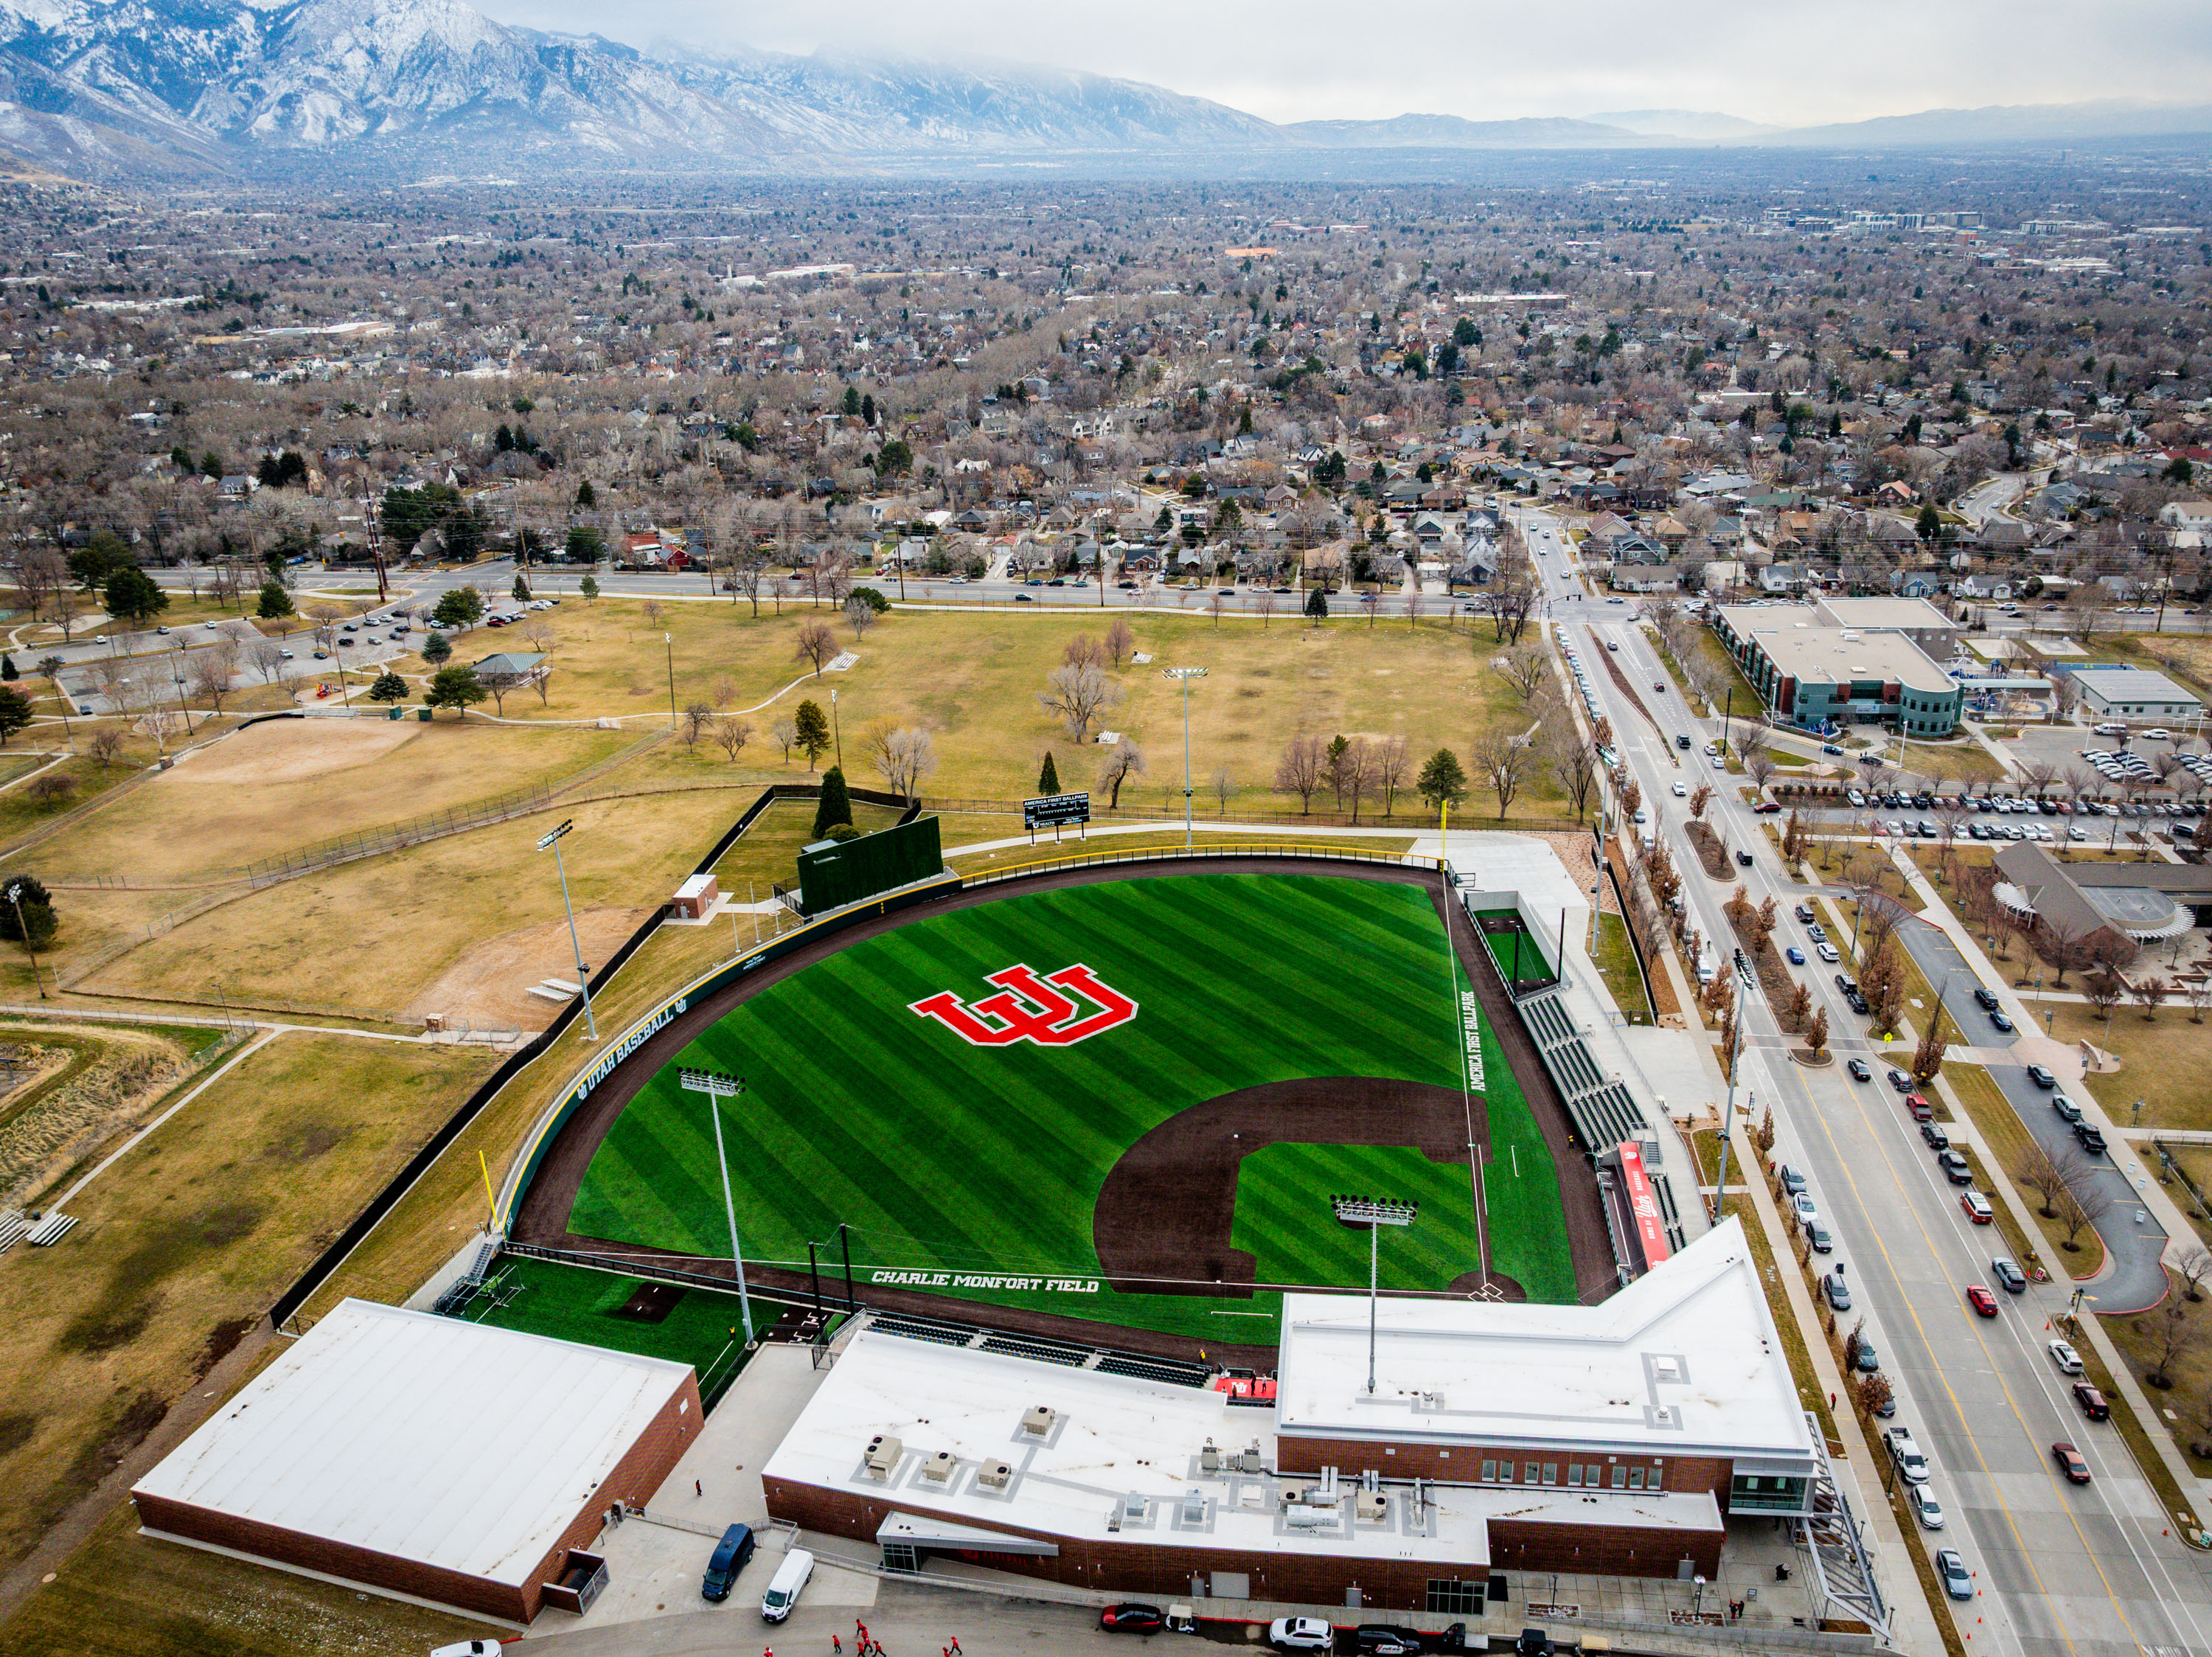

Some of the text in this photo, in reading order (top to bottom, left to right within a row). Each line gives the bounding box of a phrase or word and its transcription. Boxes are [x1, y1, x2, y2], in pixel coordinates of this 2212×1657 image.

[586, 1055, 616, 1091] UTAH
[616, 1007, 674, 1063] BASEBALL
[1461, 990, 1486, 1091] AMERICA FIRST BALLPARK
[1634, 1195, 1658, 1218] Utah
[871, 1271, 1099, 1293] CHARLIE MONFORT FIELD
